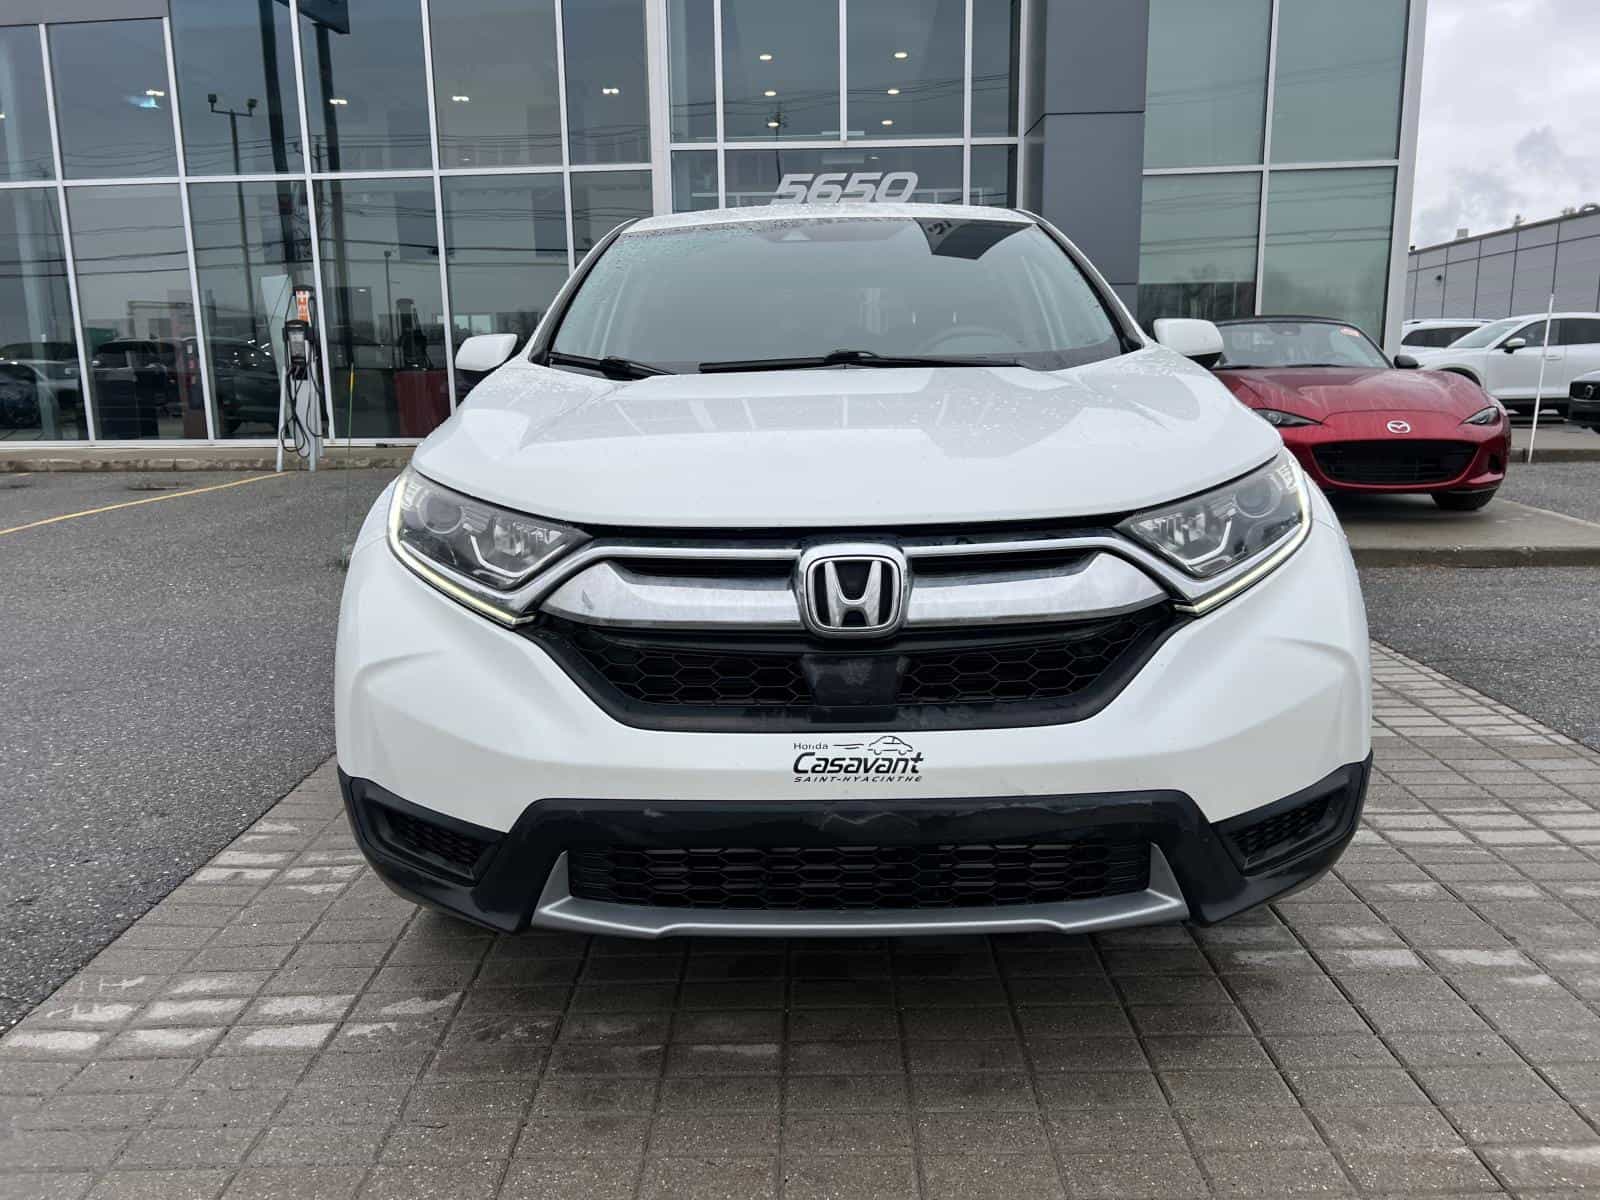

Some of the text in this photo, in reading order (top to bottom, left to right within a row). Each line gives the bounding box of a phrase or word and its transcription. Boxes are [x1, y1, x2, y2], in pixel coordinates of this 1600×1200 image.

[770, 172, 919, 205] 5650
[793, 742, 829, 750] Honda
[792, 751, 924, 774] Casavant
[793, 775, 923, 783] SAINT-HYACINTHE
